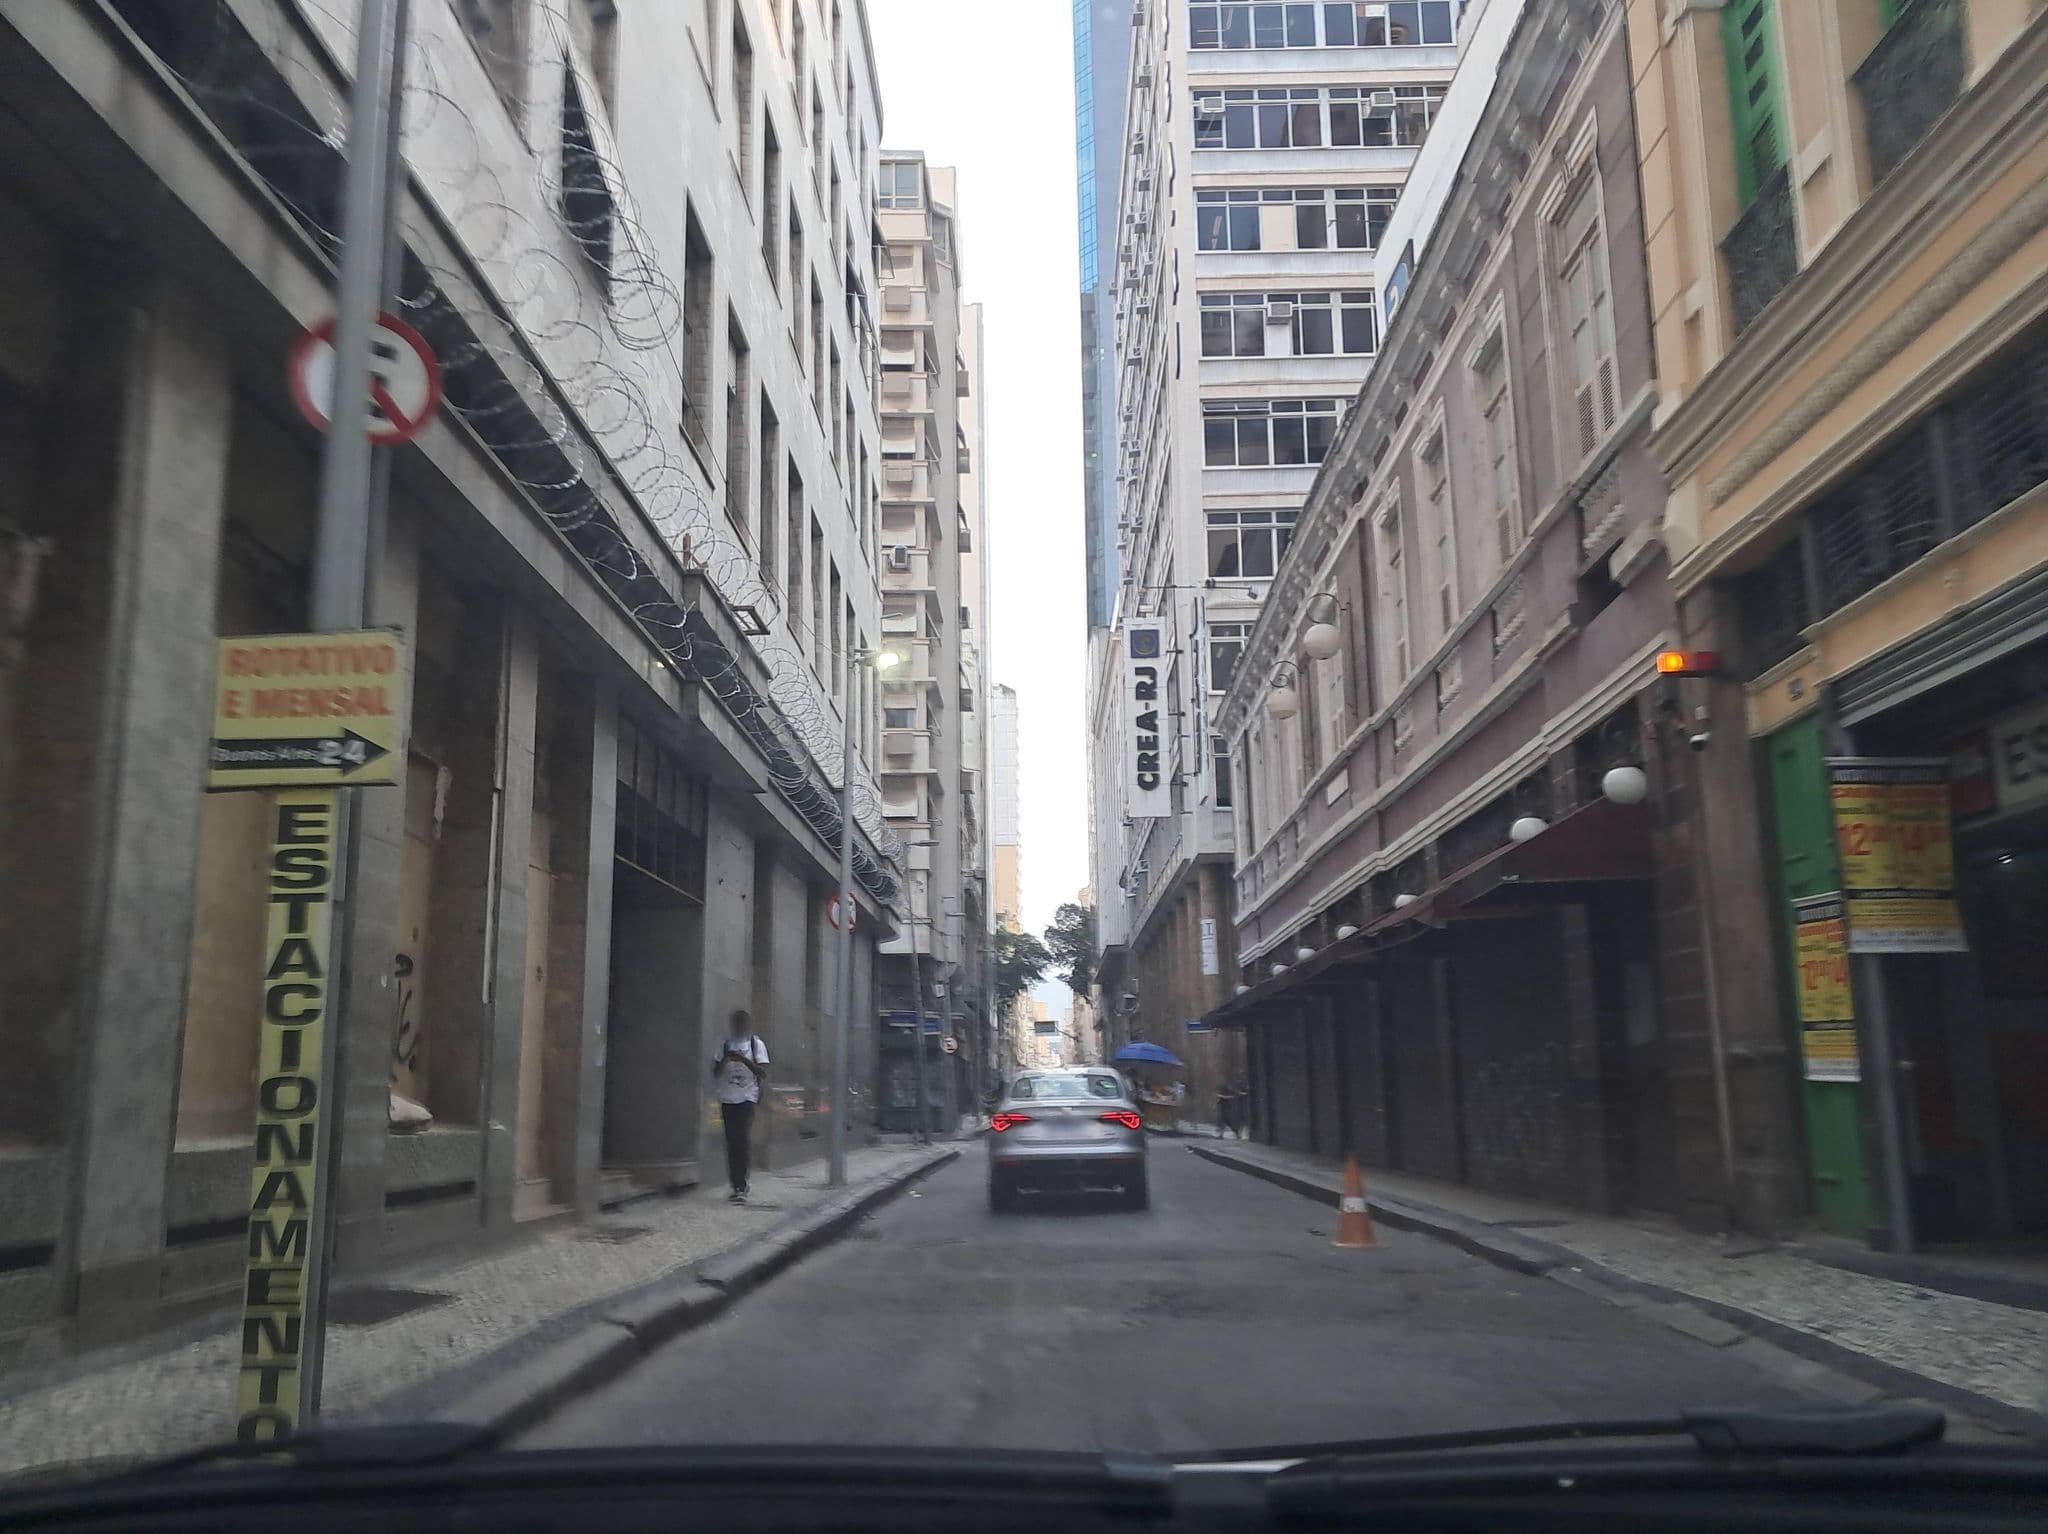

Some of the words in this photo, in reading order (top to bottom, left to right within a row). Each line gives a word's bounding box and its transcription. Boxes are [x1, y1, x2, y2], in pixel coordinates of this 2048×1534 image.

[223, 645, 396, 677] ROTATIVO
[222, 689, 241, 719] E
[252, 686, 393, 719] MENSAL
[1134, 666, 1160, 791] CREA-RJ
[317, 739, 366, 766] 24
[236, 804, 331, 1442] ESTACIONAMENTO
